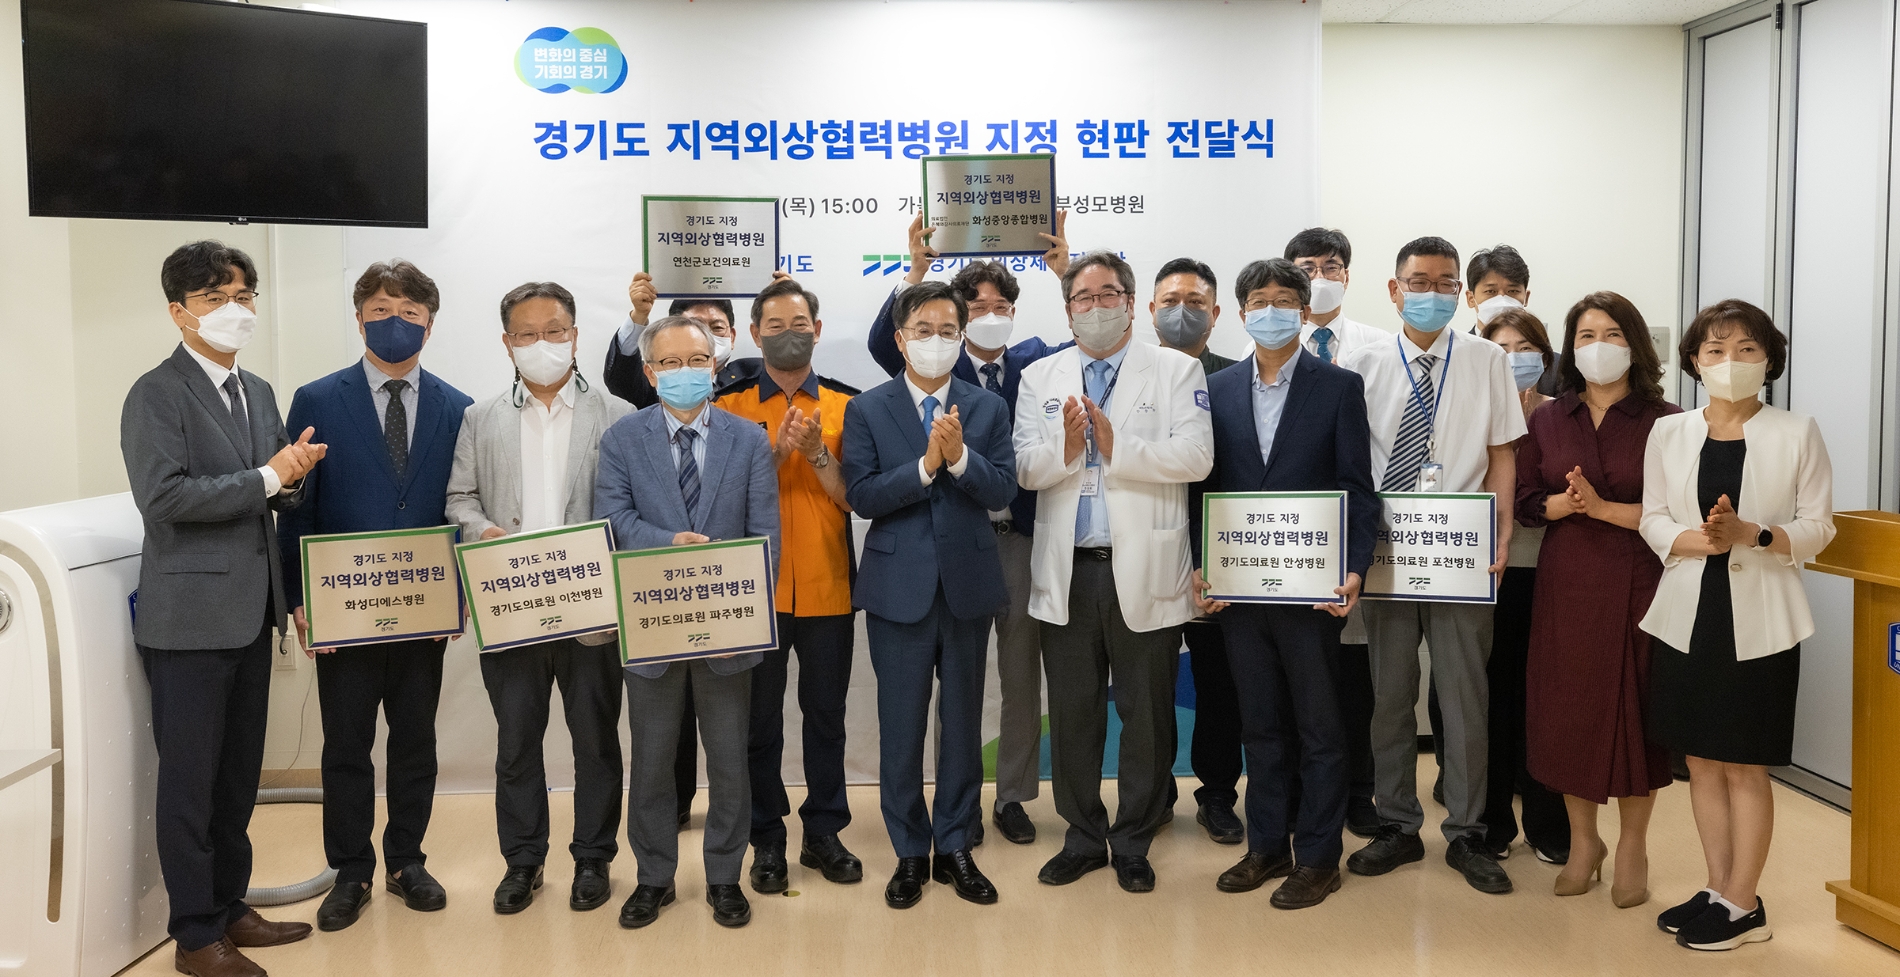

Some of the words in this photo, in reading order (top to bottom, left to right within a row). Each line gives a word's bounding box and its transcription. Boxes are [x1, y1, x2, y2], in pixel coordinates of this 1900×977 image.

[534, 48, 576, 62] 변화의
[579, 48, 607, 62] 중심
[534, 65, 576, 79] 기회의
[580, 66, 607, 79] 경기
[533, 120, 650, 160] 경기도
[666, 120, 968, 160] 지역외상협력병원
[985, 119, 1057, 155] 지정
[1076, 119, 1150, 158] 현판
[1166, 119, 1274, 158] 전달식
[964, 175, 992, 185] 경기도
[996, 174, 1014, 185] 지정
[937, 190, 1041, 205] 지역외상협력병원
[782, 198, 815, 218] (목)
[822, 198, 878, 214] 15:00
[686, 216, 715, 226] 경기도
[719, 216, 738, 226] 지정
[972, 214, 1048, 226] 화성중앙종합병원
[657, 232, 765, 247] 지역외상협력병원
[672, 257, 750, 267] 연천군보건의료원
[1246, 513, 1276, 524] 경기도
[1280, 513, 1300, 524] 지정
[1392, 513, 1424, 524] 경기도
[1428, 514, 1449, 525] 지정
[1217, 530, 1328, 546] 지역외상협력병원
[353, 553, 387, 566] 경기도
[391, 551, 413, 562] 지정
[508, 554, 541, 569] 경기도
[545, 549, 567, 561] 지정
[1220, 556, 1280, 568] 경기도의료원
[1283, 557, 1325, 569] 안성병원
[1432, 556, 1475, 569] 포천병원
[321, 566, 445, 589] 지역외상협력병원
[480, 561, 602, 593] 지역외상협력병원
[663, 567, 697, 581] 경기도
[701, 564, 723, 576] 지정
[632, 579, 756, 605] 지역외상협력병원
[344, 594, 424, 610] 화성디에스병원
[490, 595, 556, 616] 경기도의료원
[559, 587, 603, 603] 이천병원
[639, 611, 705, 629] 경기도의료원
[709, 605, 754, 620] 파주병원
